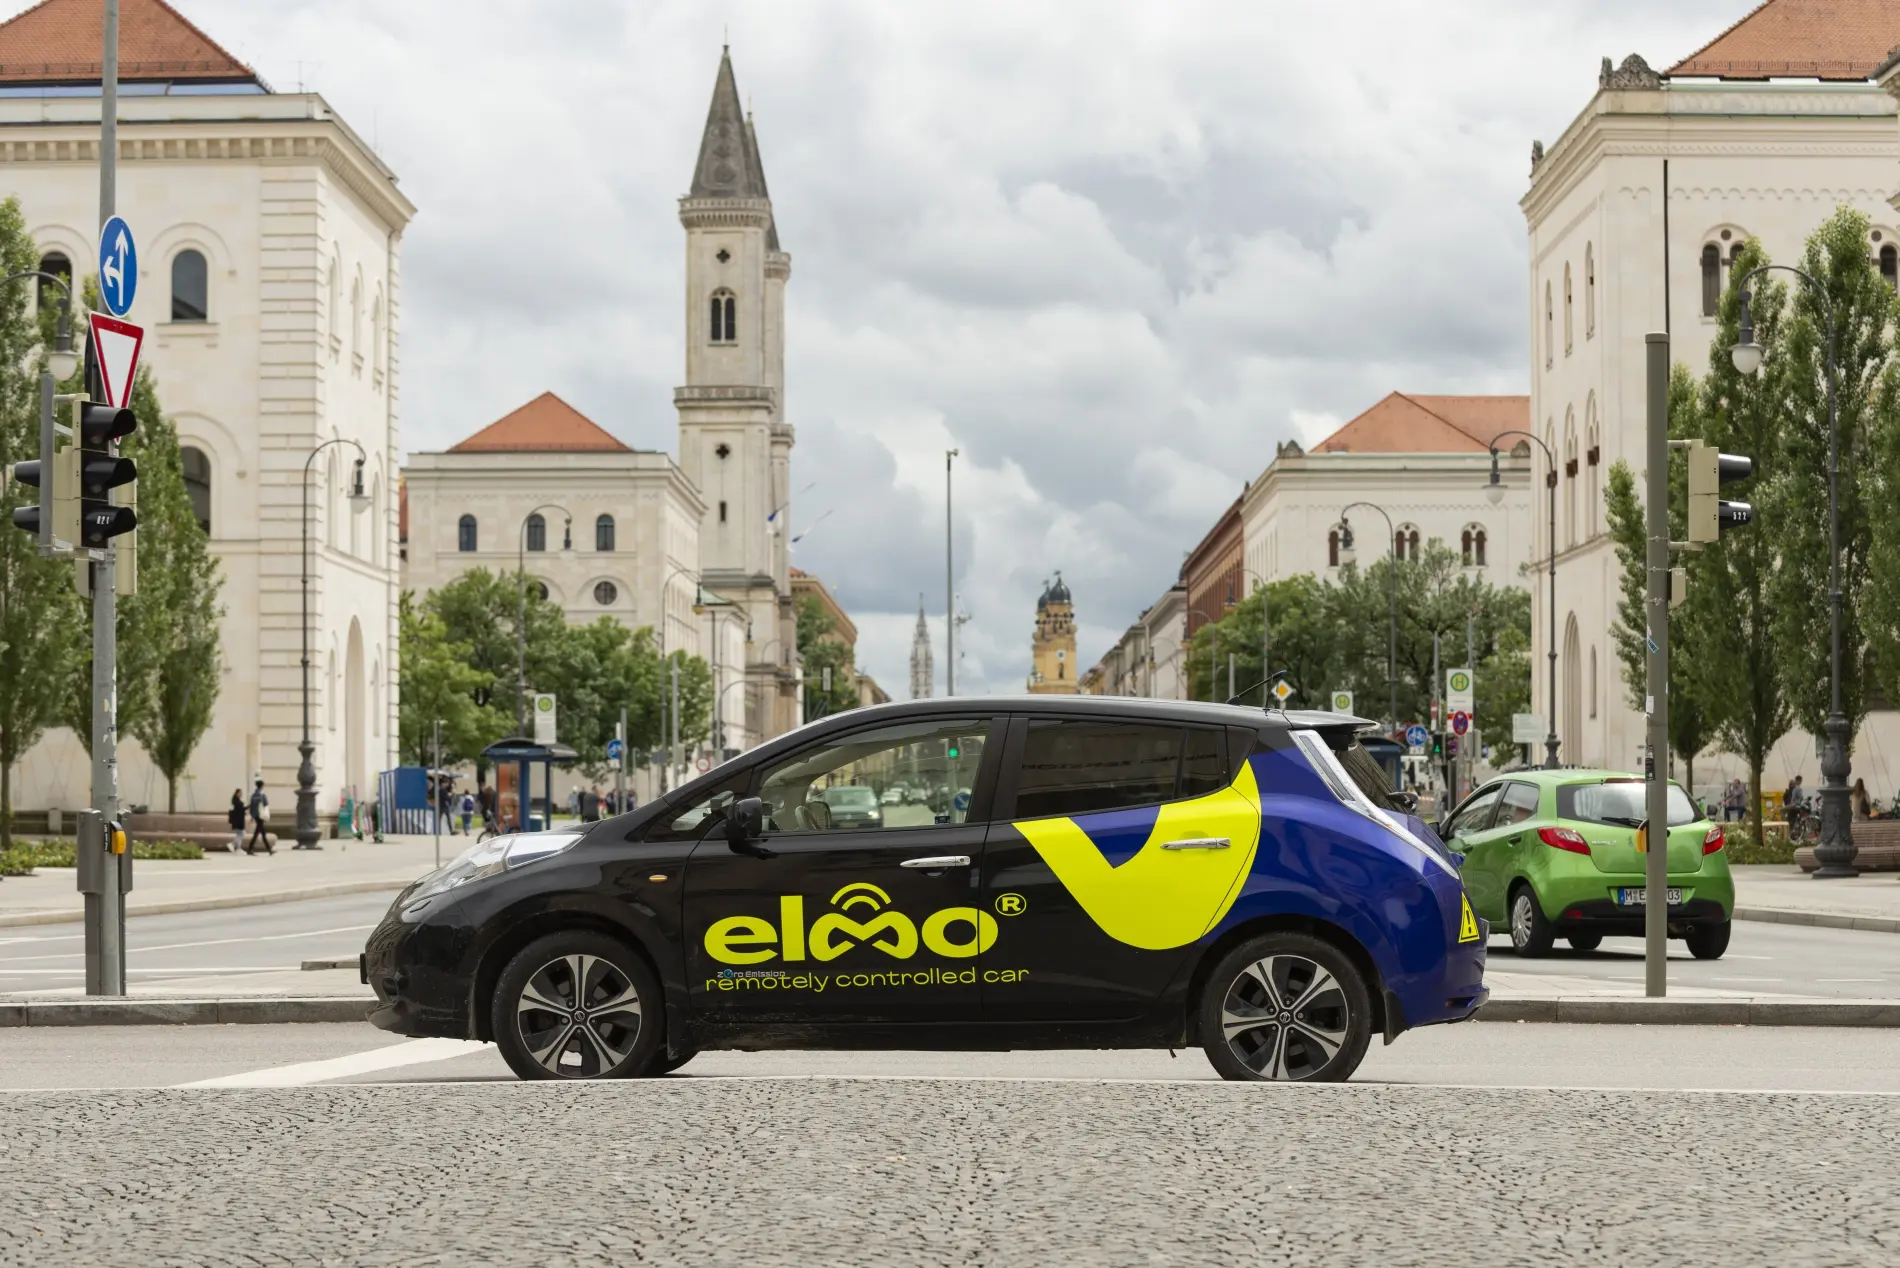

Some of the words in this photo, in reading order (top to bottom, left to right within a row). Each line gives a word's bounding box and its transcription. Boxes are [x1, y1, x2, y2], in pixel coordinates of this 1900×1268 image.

[1733, 511, 1747, 520] 522
[704, 888, 998, 965] elmo
[706, 972, 829, 992] remotely
[836, 967, 976, 988] controlled
[983, 968, 1030, 984] car
